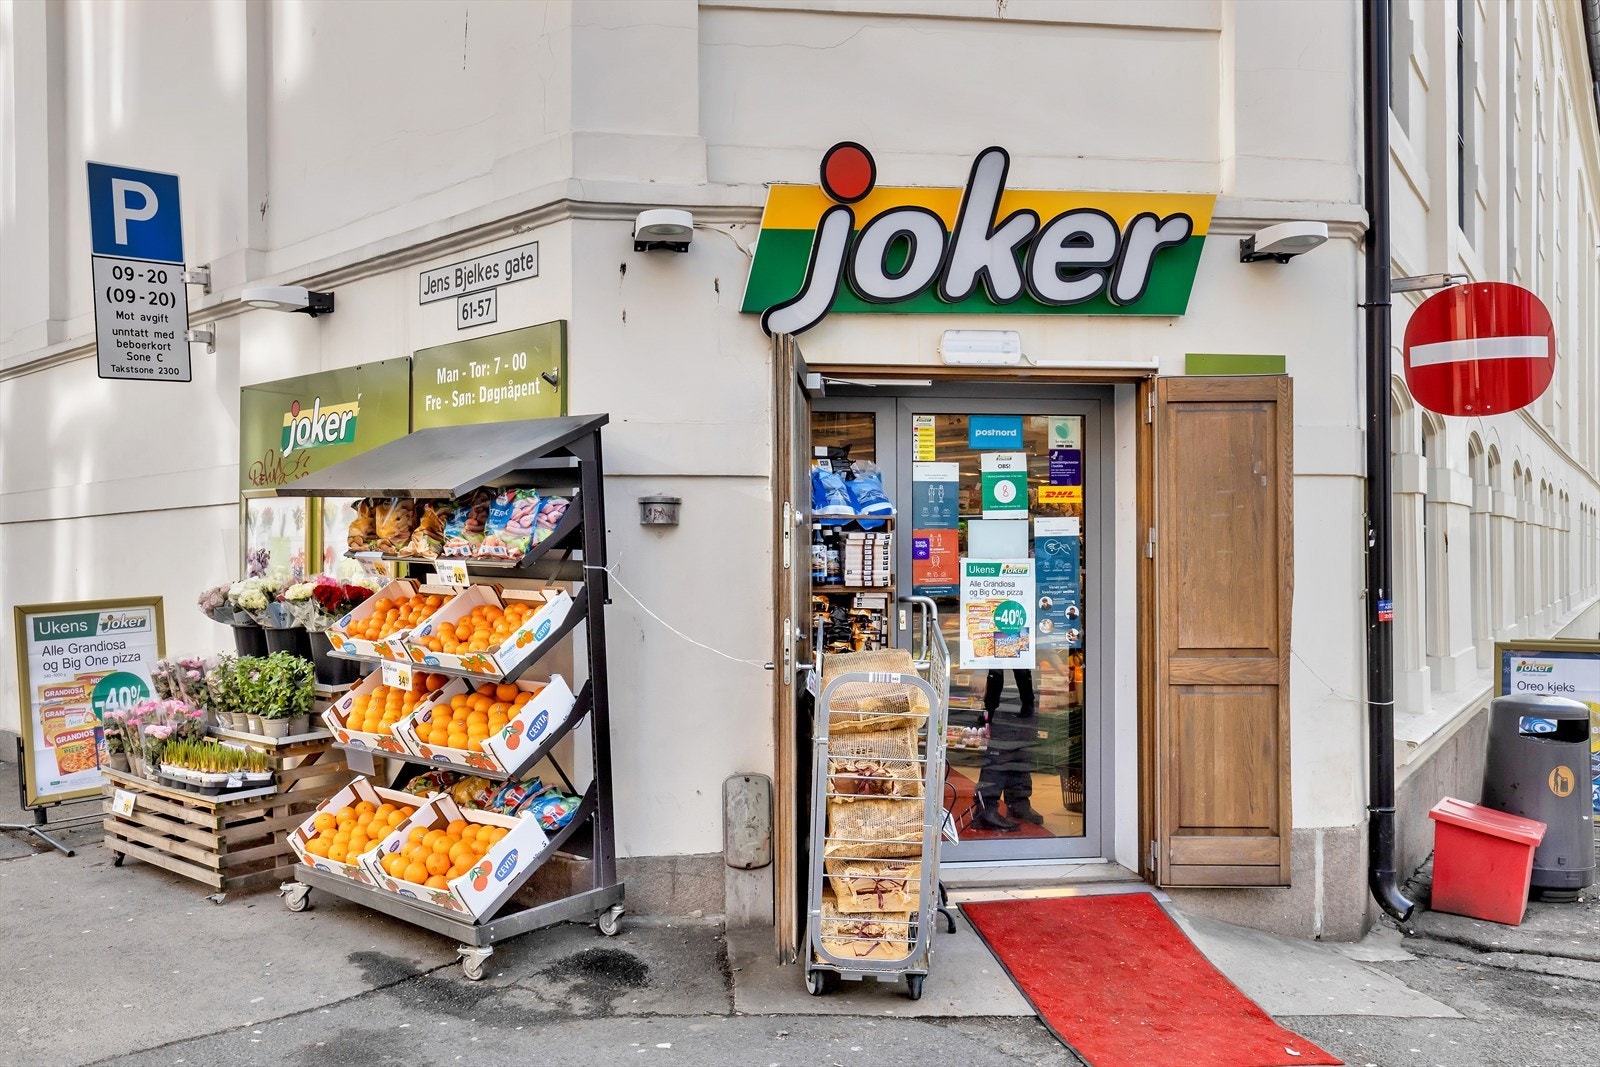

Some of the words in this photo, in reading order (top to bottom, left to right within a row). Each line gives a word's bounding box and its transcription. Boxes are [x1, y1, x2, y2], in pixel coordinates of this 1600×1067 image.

[112, 178, 159, 246] P
[760, 141, 1194, 335] joker
[424, 275, 450, 295] Jens
[455, 261, 500, 292] Bjelkes
[505, 252, 533, 281] gate
[462, 297, 492, 321] 61-57
[116, 310, 135, 321] Mot
[140, 313, 169, 324] avgift
[112, 328, 149, 339] unntatt
[154, 330, 175, 340] med
[116, 339, 172, 352] beboerkort
[126, 352, 152, 362] Sone
[156, 354, 164, 363] C
[111, 365, 154, 375] Takstsone
[159, 367, 180, 376] 2300
[437, 366, 459, 384] Man
[470, 361, 492, 379] Tor:
[494, 356, 501, 373] 7
[512, 352, 527, 371] 00
[425, 394, 442, 411] Fre
[451, 387, 476, 408] Søn:
[479, 378, 541, 403] Døgnåpent
[282, 397, 354, 458] joker
[975, 429, 1017, 438] postnord
[969, 565, 995, 575] Ukens
[1003, 564, 1027, 576] joker
[969, 580, 982, 588] Alle
[983, 580, 1016, 588] Grandiosa
[969, 590, 978, 598] og
[980, 589, 990, 597] Big
[1007, 589, 1024, 597] pizza
[39, 621, 88, 635] Ukens
[103, 614, 145, 634] joker
[994, 609, 1024, 626] -40%
[42, 645, 64, 657] Alle
[68, 641, 126, 655] Grandiosa
[43, 662, 58, 673] og
[62, 657, 81, 671] Big
[84, 655, 109, 667] One
[112, 652, 141, 667] pizza
[1518, 660, 1551, 673] joker
[45, 687, 84, 698] GRANDIOSA
[1517, 681, 1544, 692] Oreo
[1547, 682, 1576, 695] kjeks
[528, 713, 549, 738] CEVITA
[56, 729, 95, 744] GRANDIOS
[497, 852, 518, 878] CEVITA
